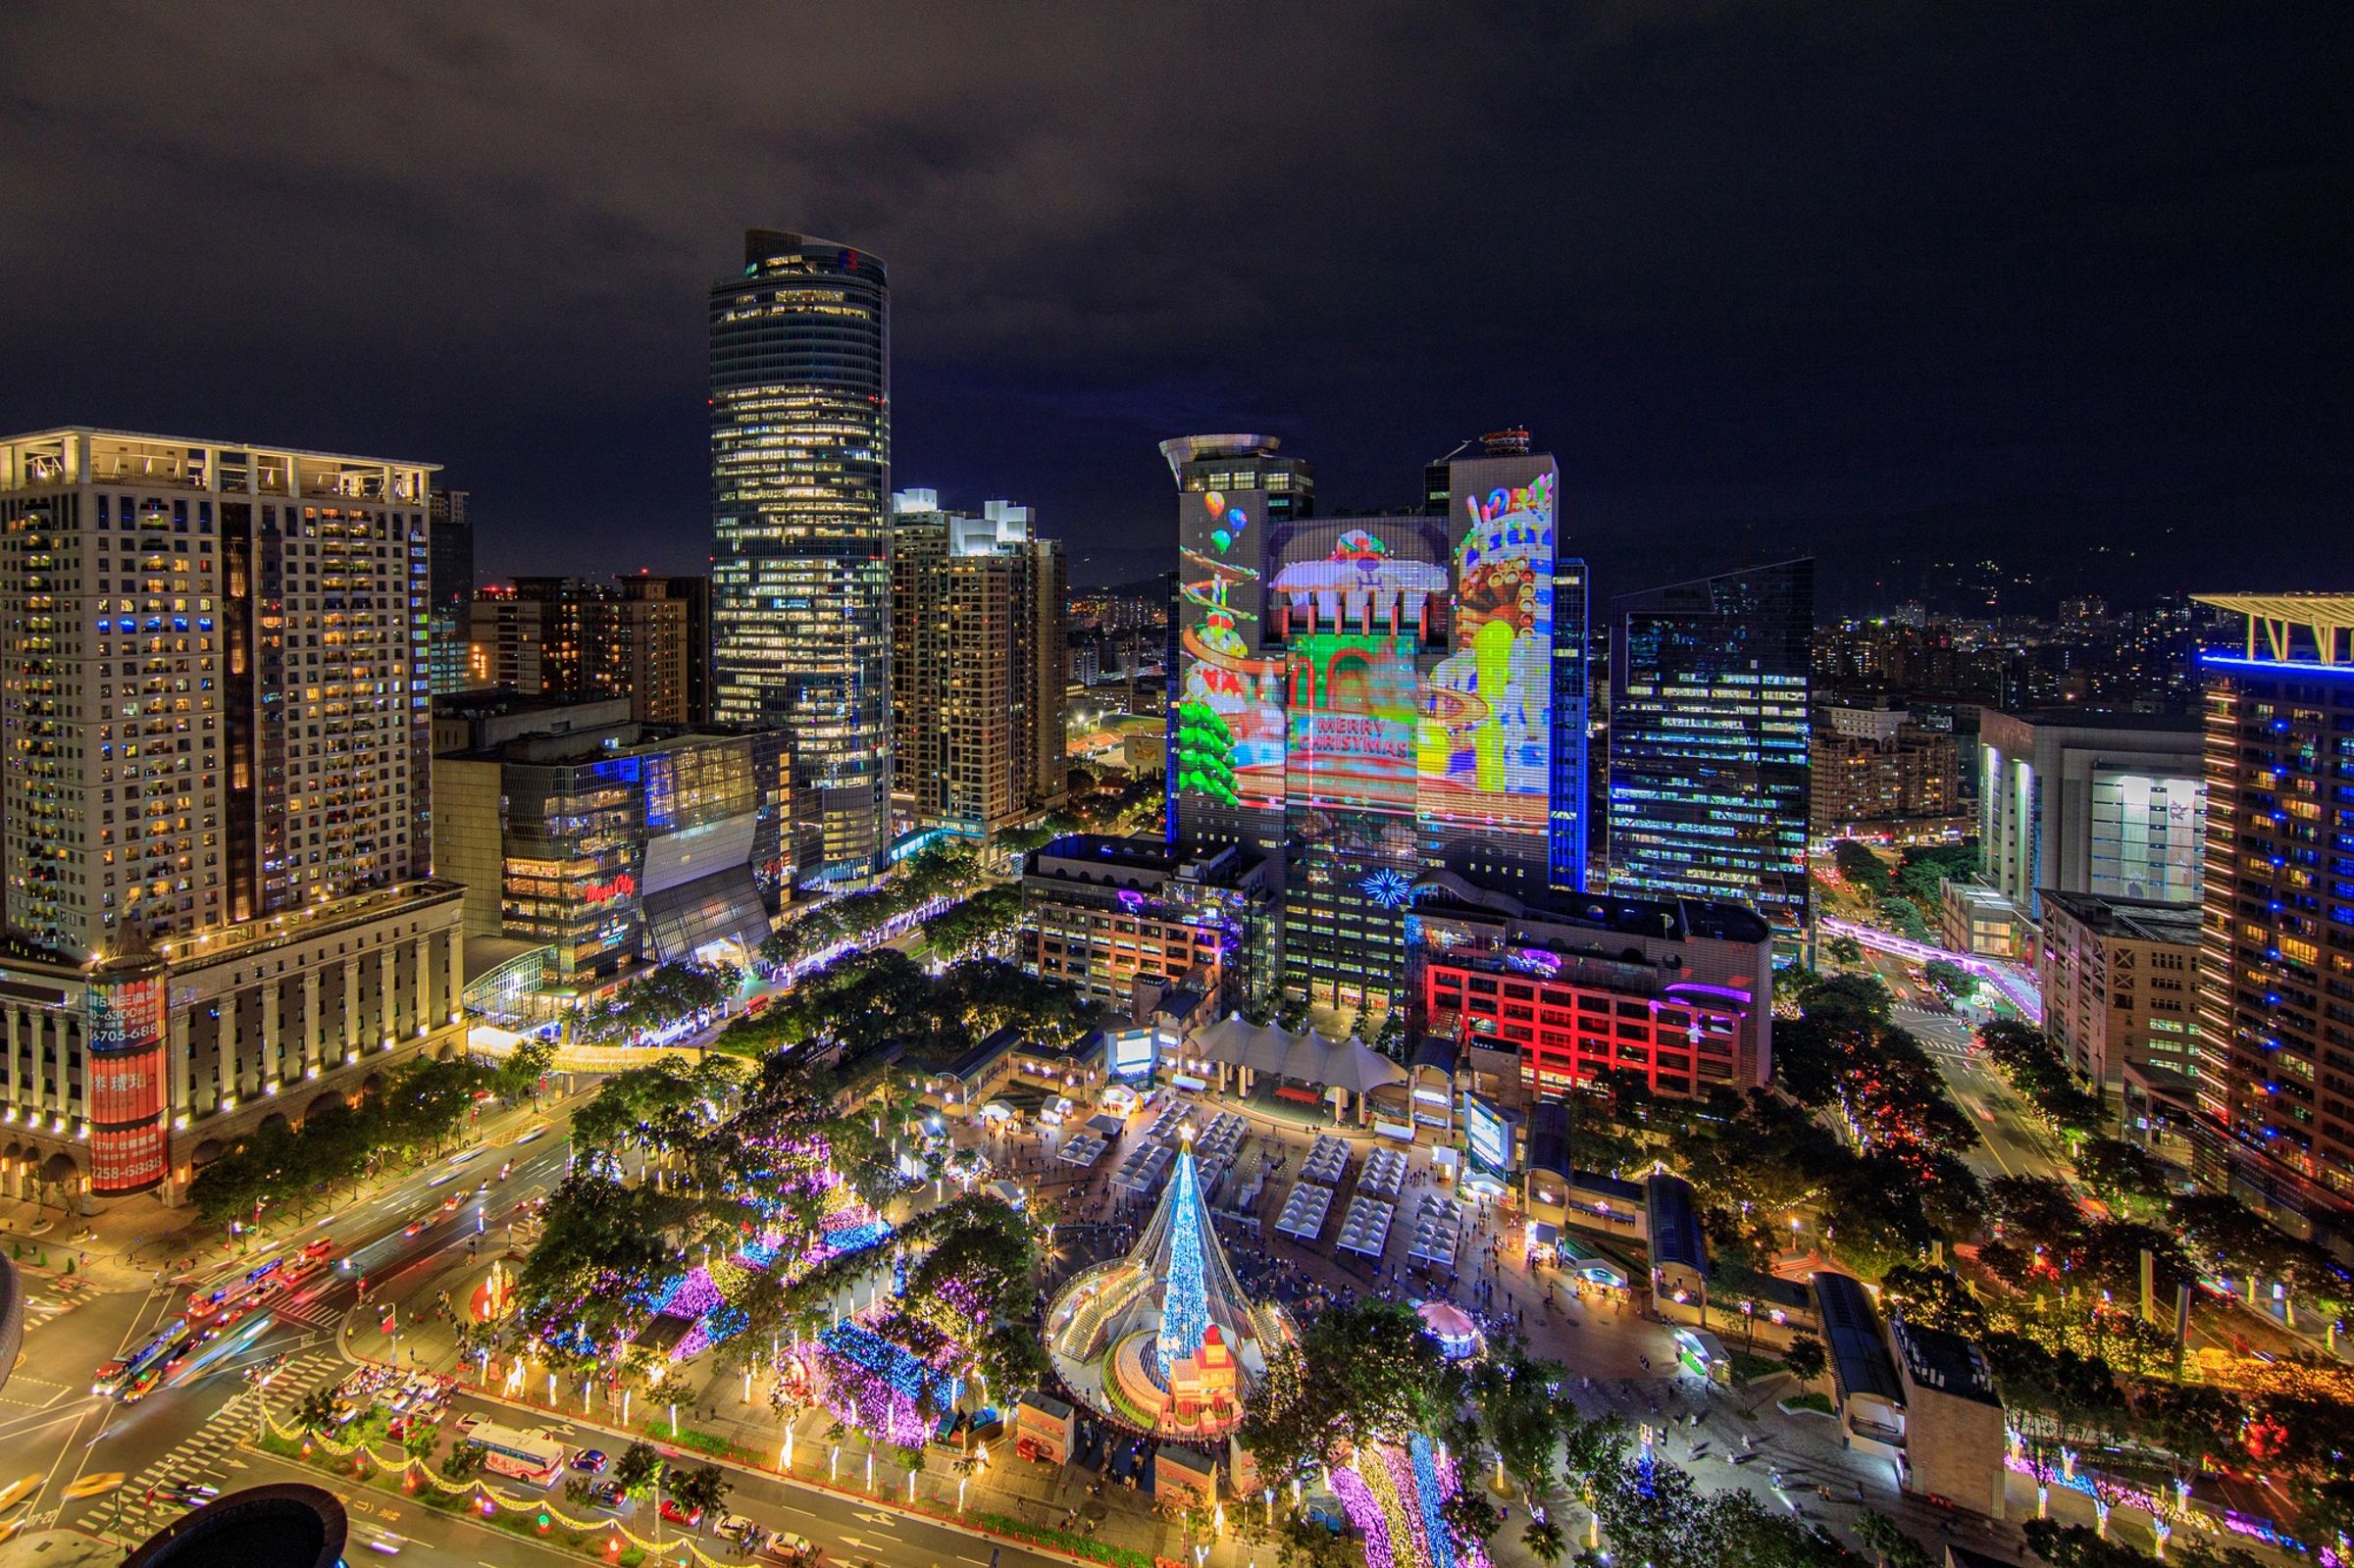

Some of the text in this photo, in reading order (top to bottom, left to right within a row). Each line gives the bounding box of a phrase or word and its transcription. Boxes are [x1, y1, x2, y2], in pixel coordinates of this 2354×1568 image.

[1317, 718, 1385, 736] MERRY
[1299, 734, 1407, 758] CHRISTMAS
[586, 874, 635, 906] Mega City
